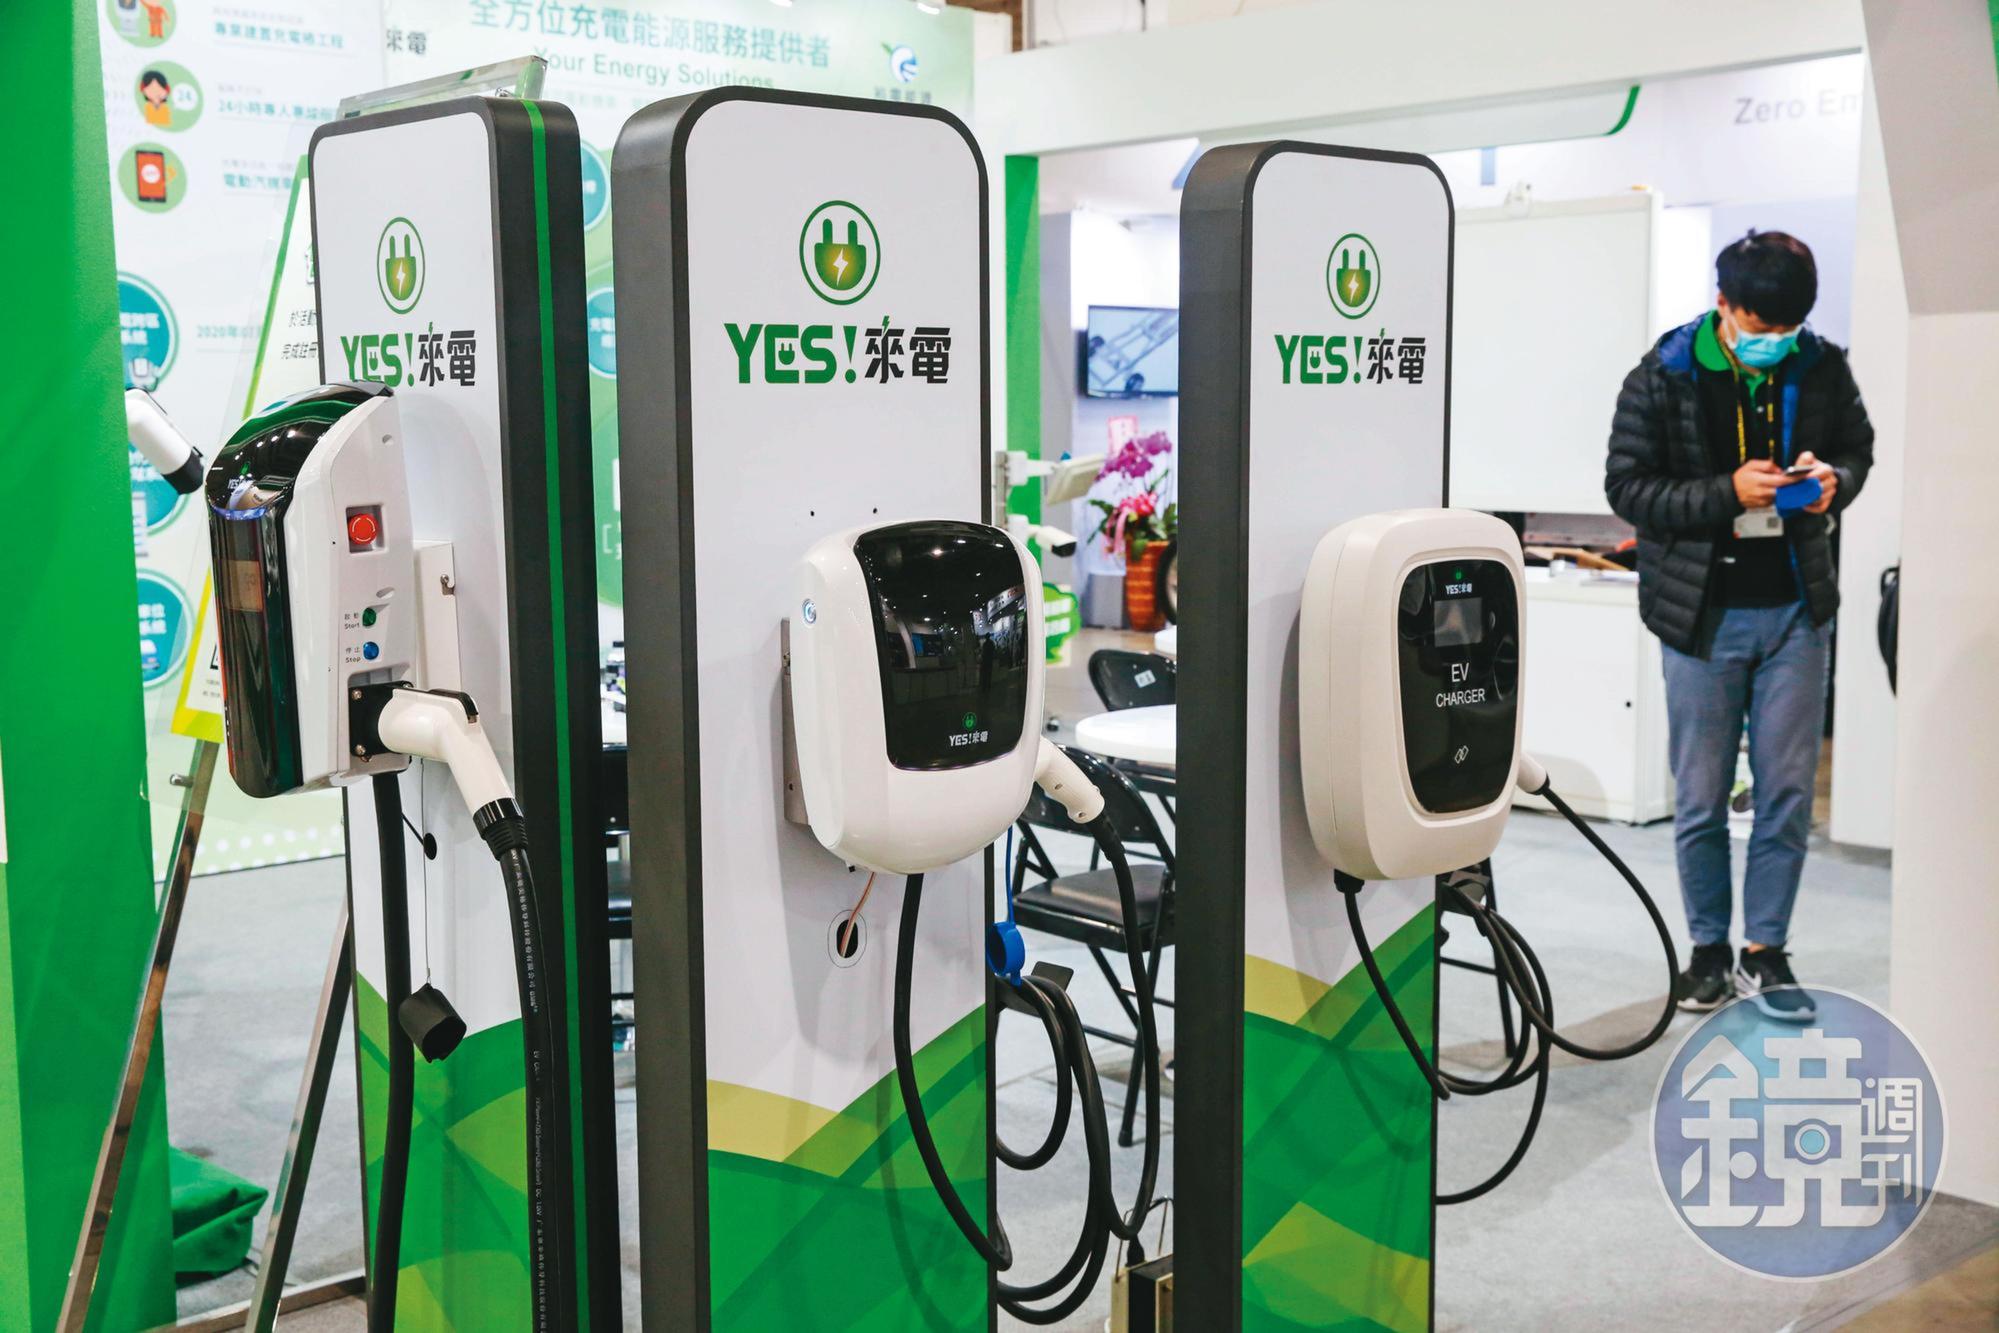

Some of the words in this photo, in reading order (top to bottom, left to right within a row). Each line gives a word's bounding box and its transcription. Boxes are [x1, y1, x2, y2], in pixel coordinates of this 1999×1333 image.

[471, 0, 830, 68] 全方位充電能源服務提供者
[533, 45, 584, 73] Your
[593, 53, 670, 86] Energy
[677, 63, 774, 89] Solutions
[1735, 97, 1806, 124] Zero
[345, 656, 361, 664] Stop
[1451, 662, 1470, 683] EV
[1435, 688, 1486, 708] CHARGER
